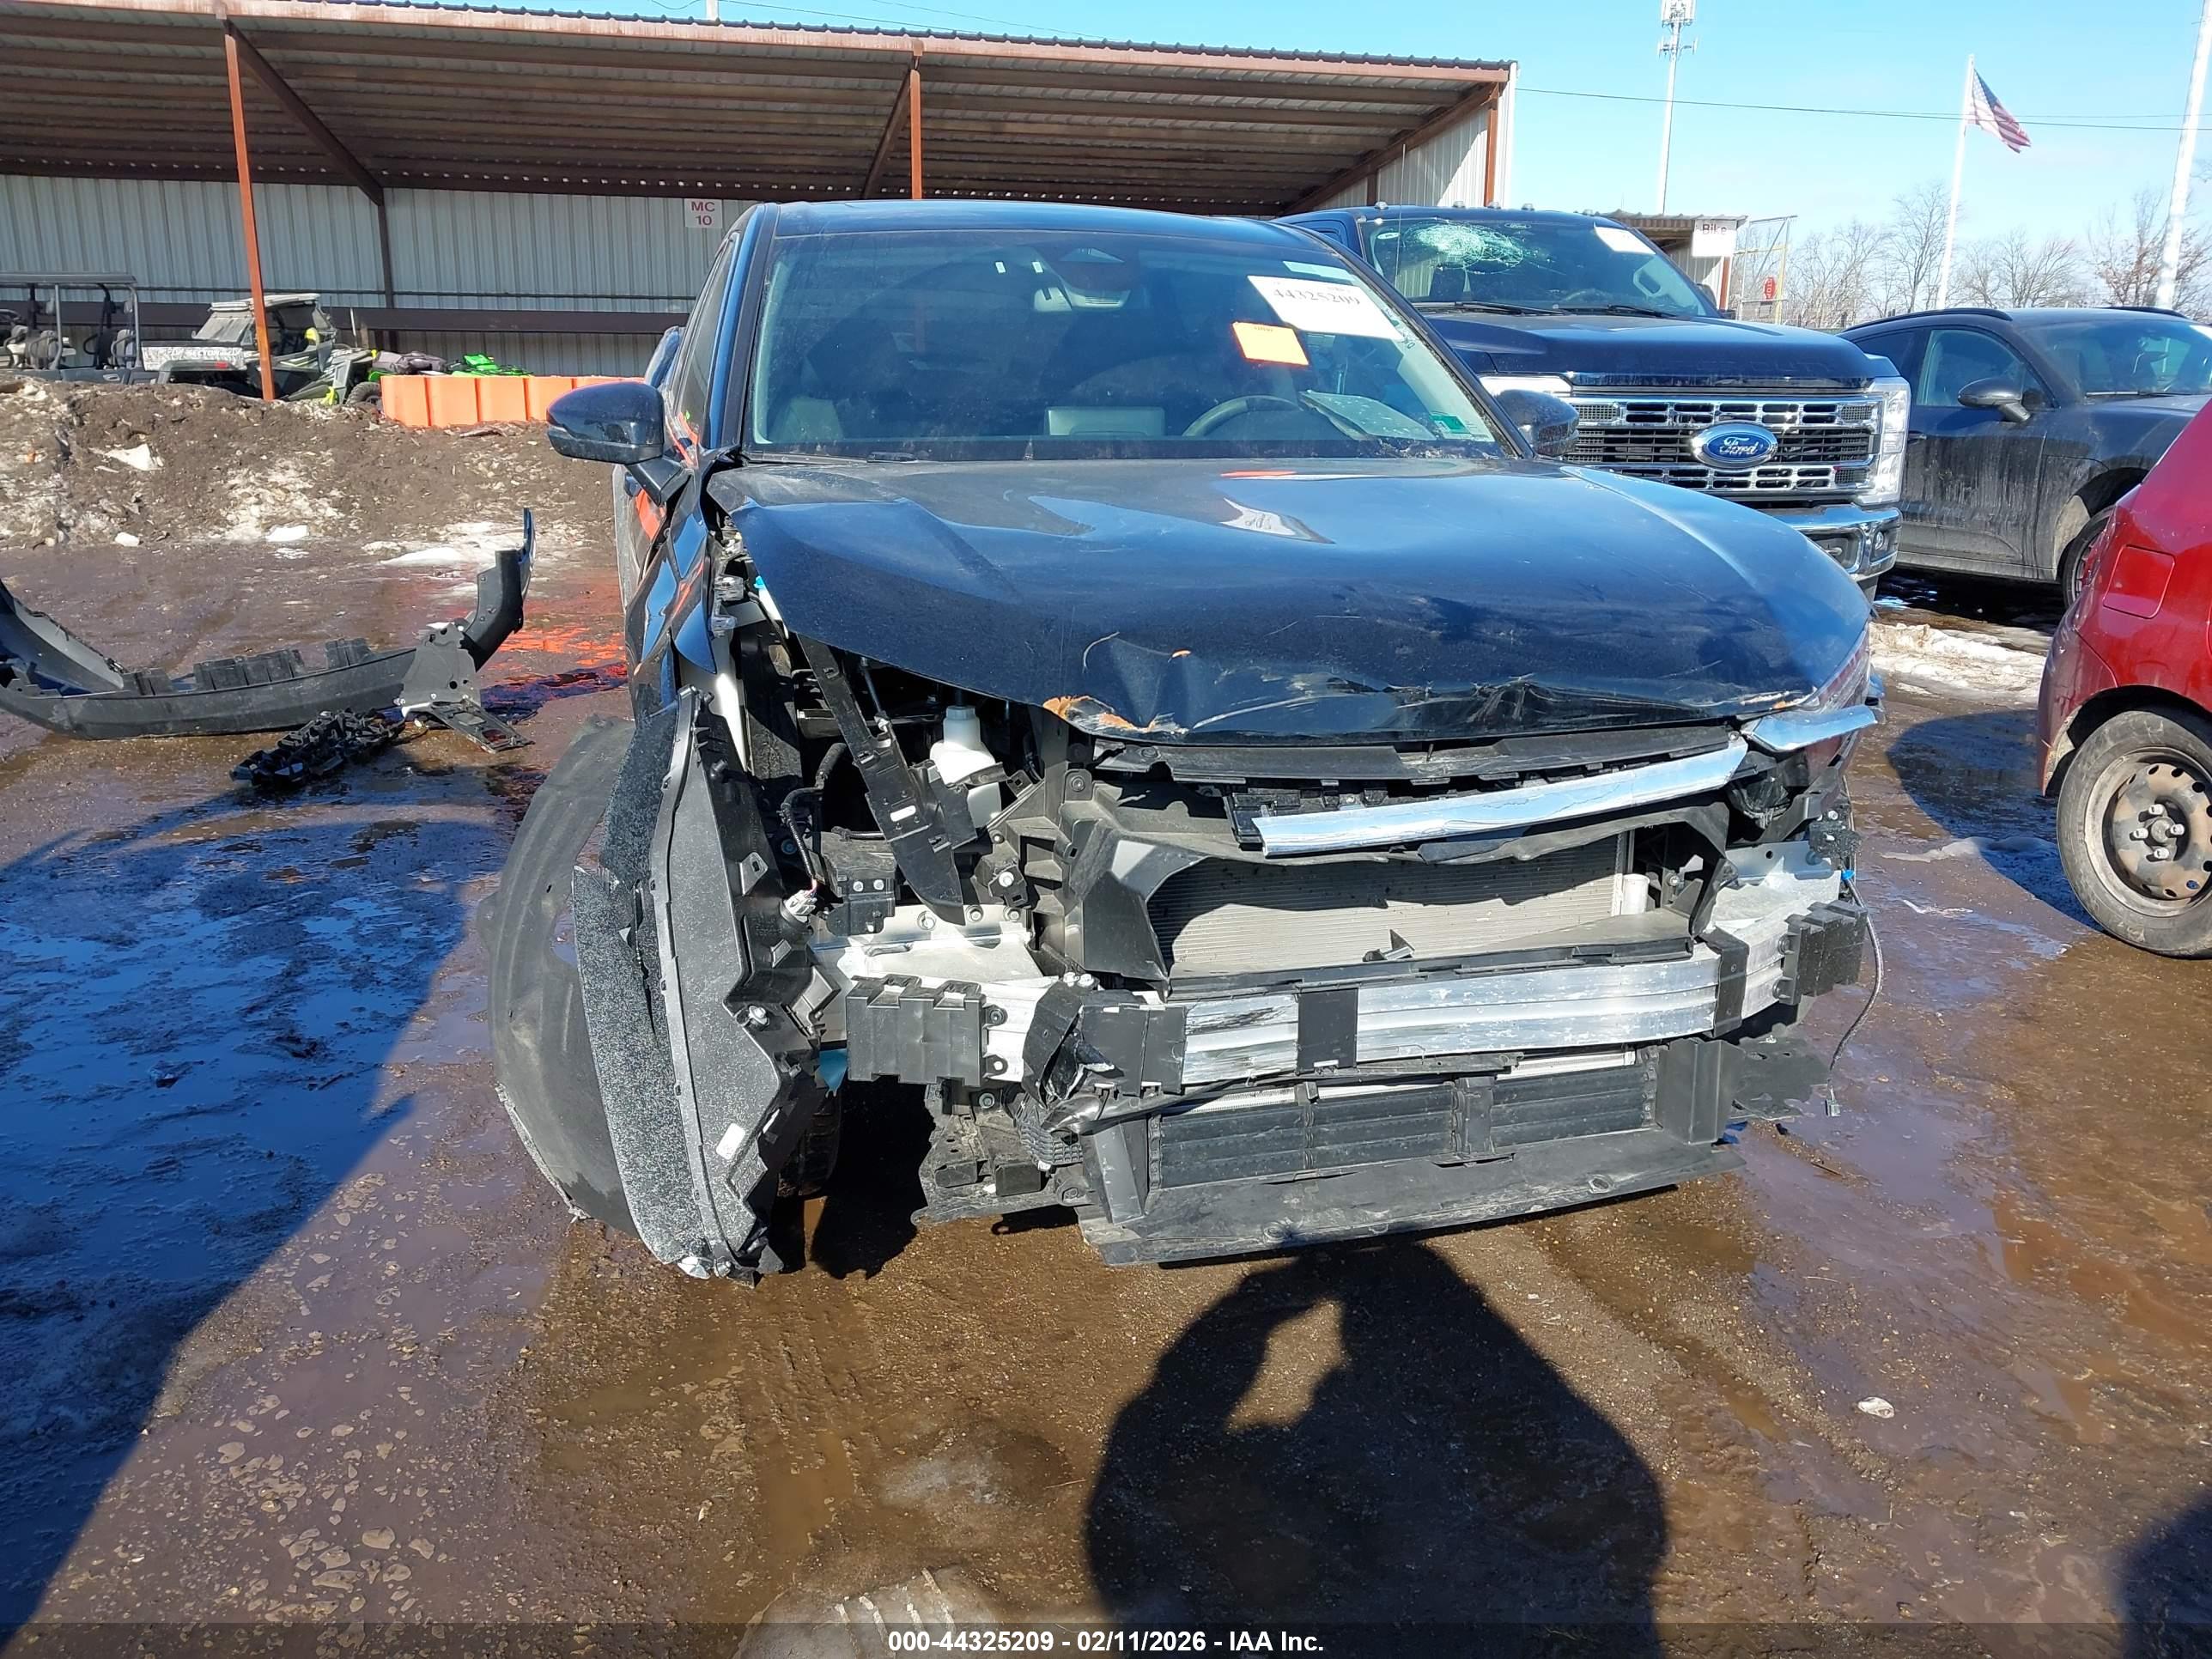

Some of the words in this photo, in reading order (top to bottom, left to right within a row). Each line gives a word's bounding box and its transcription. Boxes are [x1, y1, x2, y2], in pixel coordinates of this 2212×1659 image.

[690, 201, 715, 212] MC
[695, 215, 713, 226] 10
[1719, 436, 1760, 455] Ford
